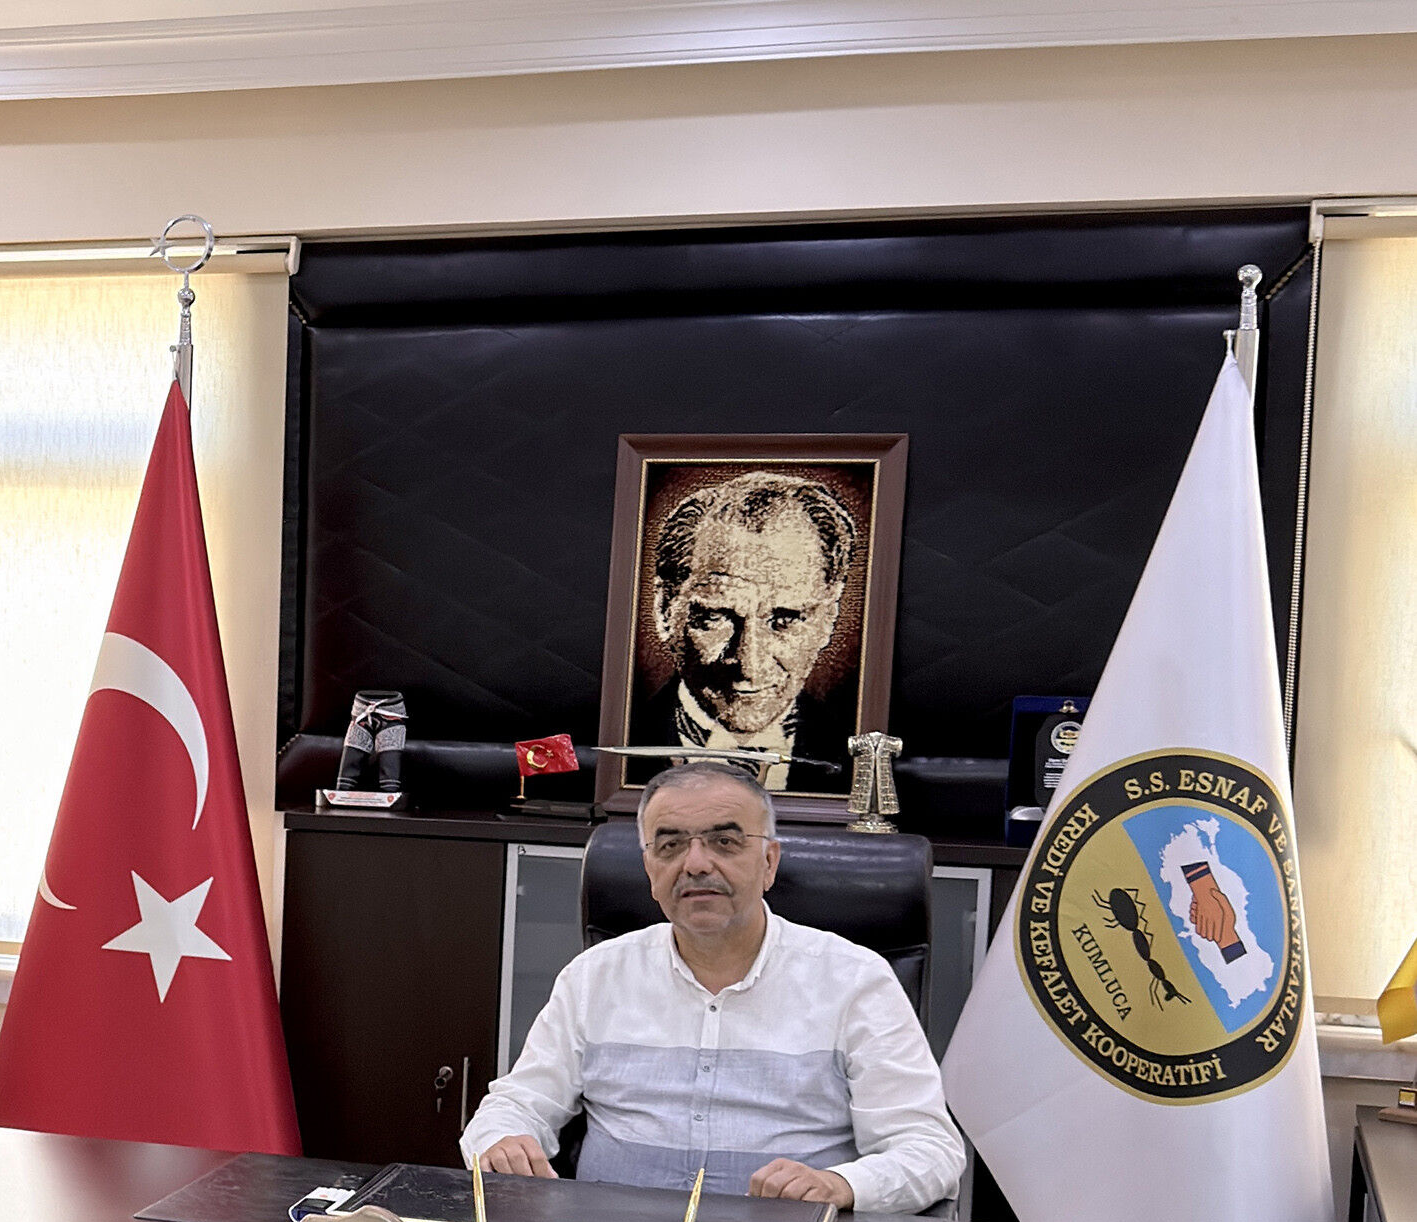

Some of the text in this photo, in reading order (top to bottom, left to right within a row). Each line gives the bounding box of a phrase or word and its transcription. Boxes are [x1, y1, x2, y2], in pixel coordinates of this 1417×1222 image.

[1043, 803, 1101, 876] KREDİ
[1030, 880, 1055, 913] VE
[1123, 769, 1302, 1053] S.S. ESNAF VE SANATKARLAR
[1029, 920, 1088, 1027] KEFALET
[1071, 923, 1133, 1022] KUMLUCA
[1082, 1025, 1227, 1086] KOOPERATİFİ
